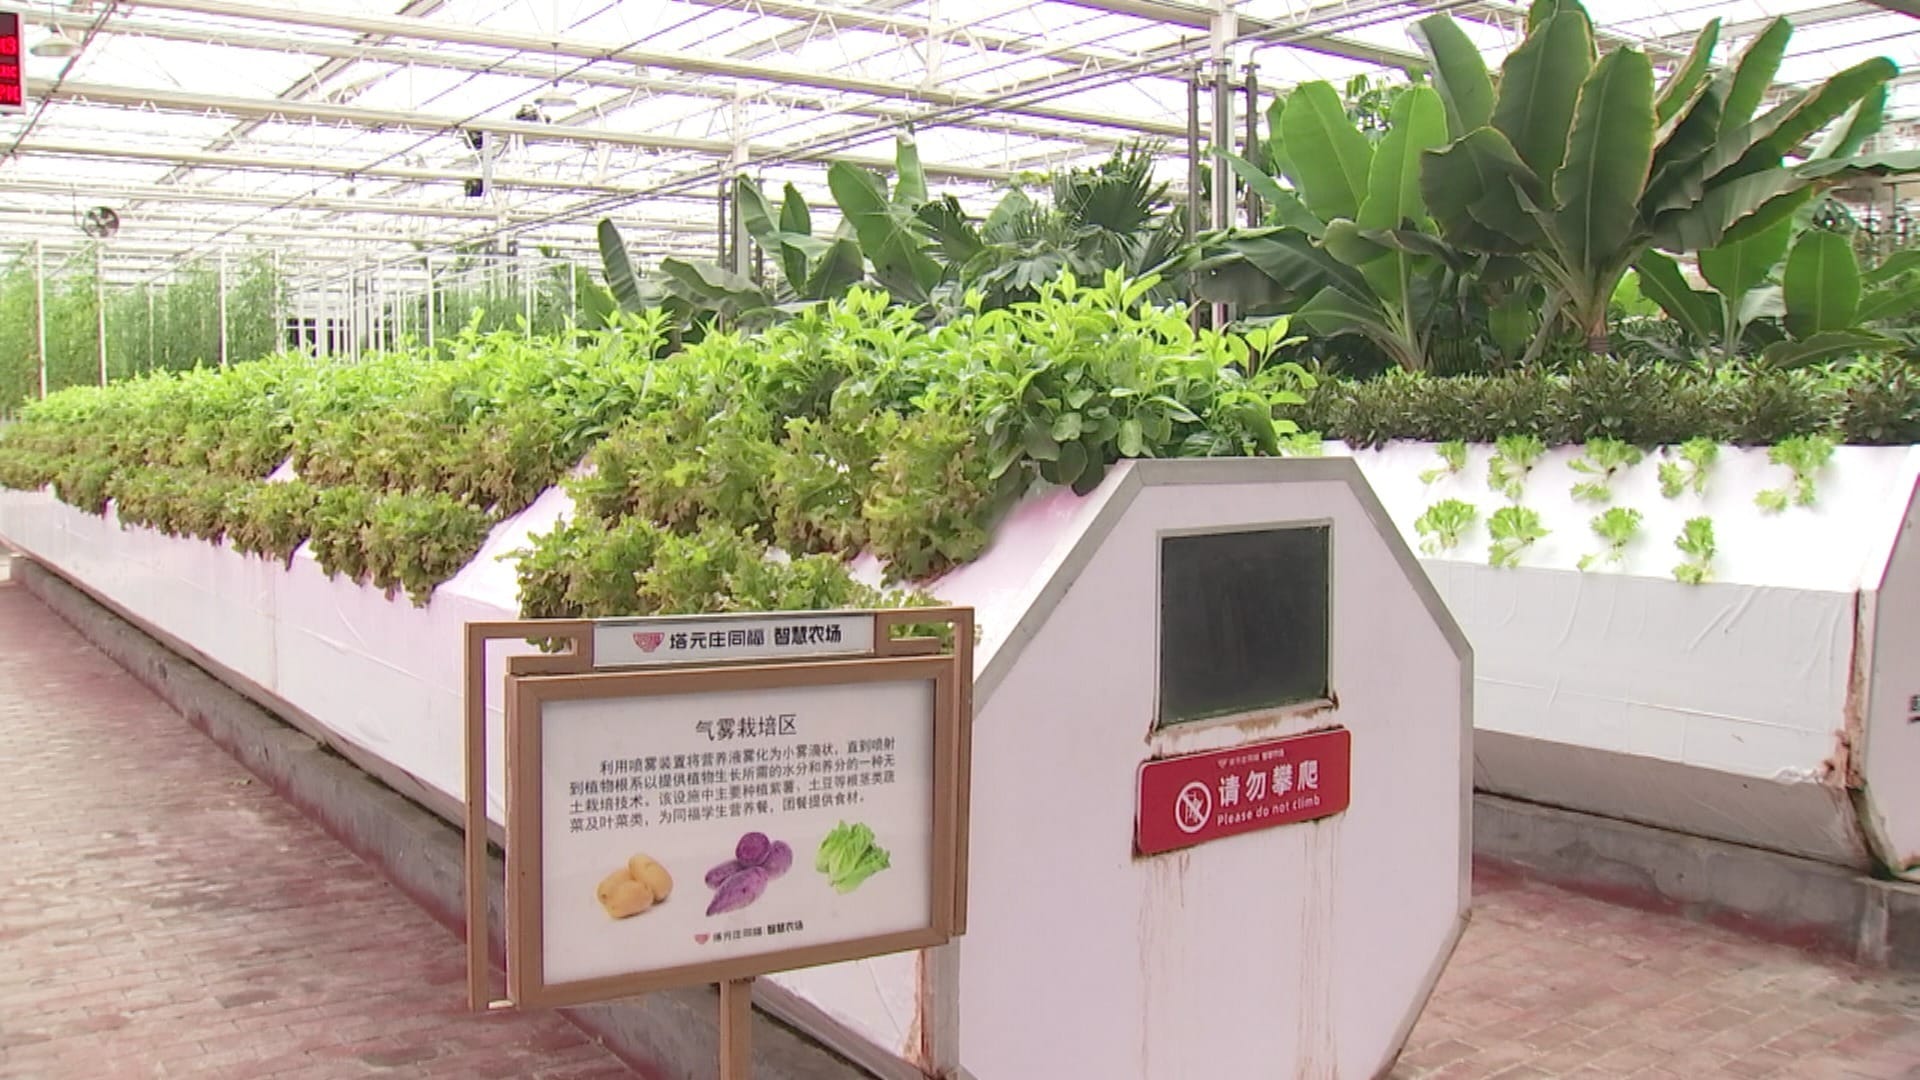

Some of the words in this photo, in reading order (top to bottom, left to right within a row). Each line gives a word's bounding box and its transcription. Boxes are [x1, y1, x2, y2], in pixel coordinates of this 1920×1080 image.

[670, 628, 764, 650] 塔元庄同福
[774, 624, 842, 646] 智慧农场
[695, 713, 797, 742] 气雾栽培区
[569, 754, 895, 797] 到植物根系以提供植物生长所需的水分和养分的一种无
[1218, 760, 1319, 807] 请勿攀爬
[1217, 810, 1252, 827] Please
[1256, 806, 1270, 818] do
[1272, 801, 1290, 815] not
[1292, 795, 1321, 810] climb
